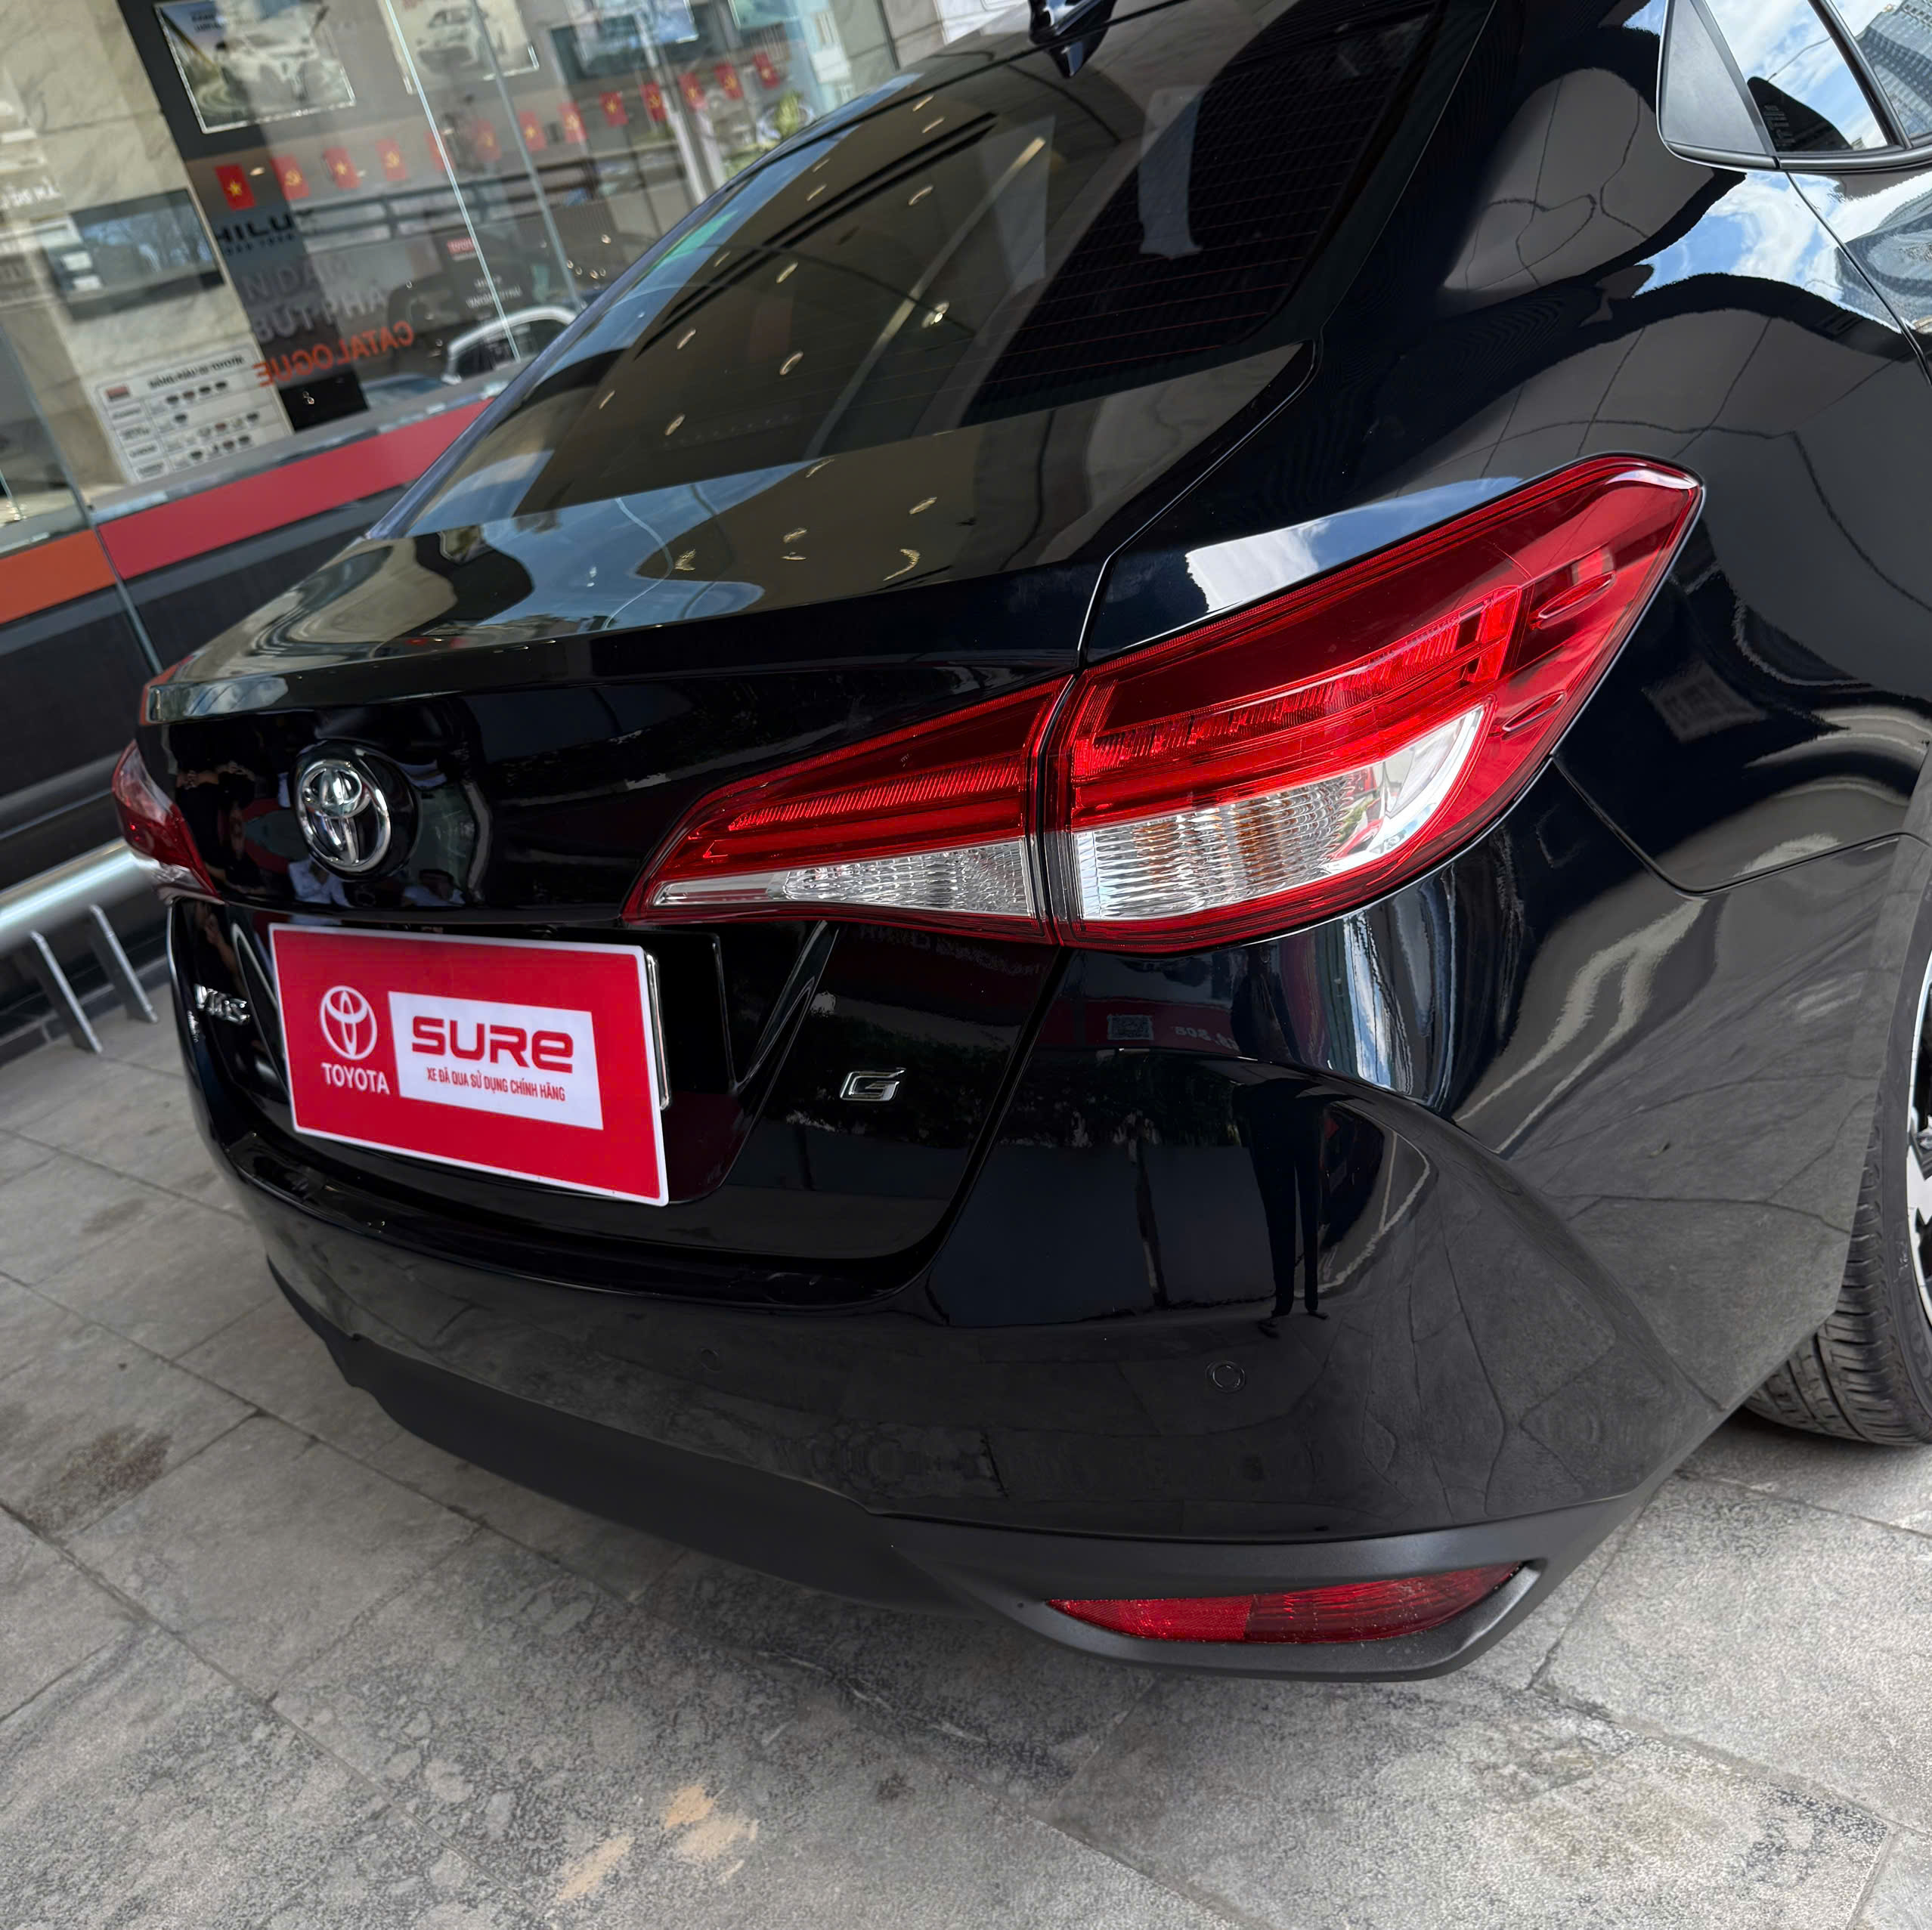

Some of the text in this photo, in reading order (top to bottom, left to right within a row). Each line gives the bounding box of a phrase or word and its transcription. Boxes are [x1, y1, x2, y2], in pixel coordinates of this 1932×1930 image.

[320, 1062, 390, 1095] TOYOTA
[426, 1067, 438, 1082] XE
[438, 1066, 451, 1084] ĐÃ
[452, 1071, 469, 1087] QUA
[485, 1076, 508, 1095] DỤNG
[509, 1076, 538, 1096] CHÍNH
[540, 1081, 566, 1102] HÃNG
[839, 1067, 906, 1102] G
